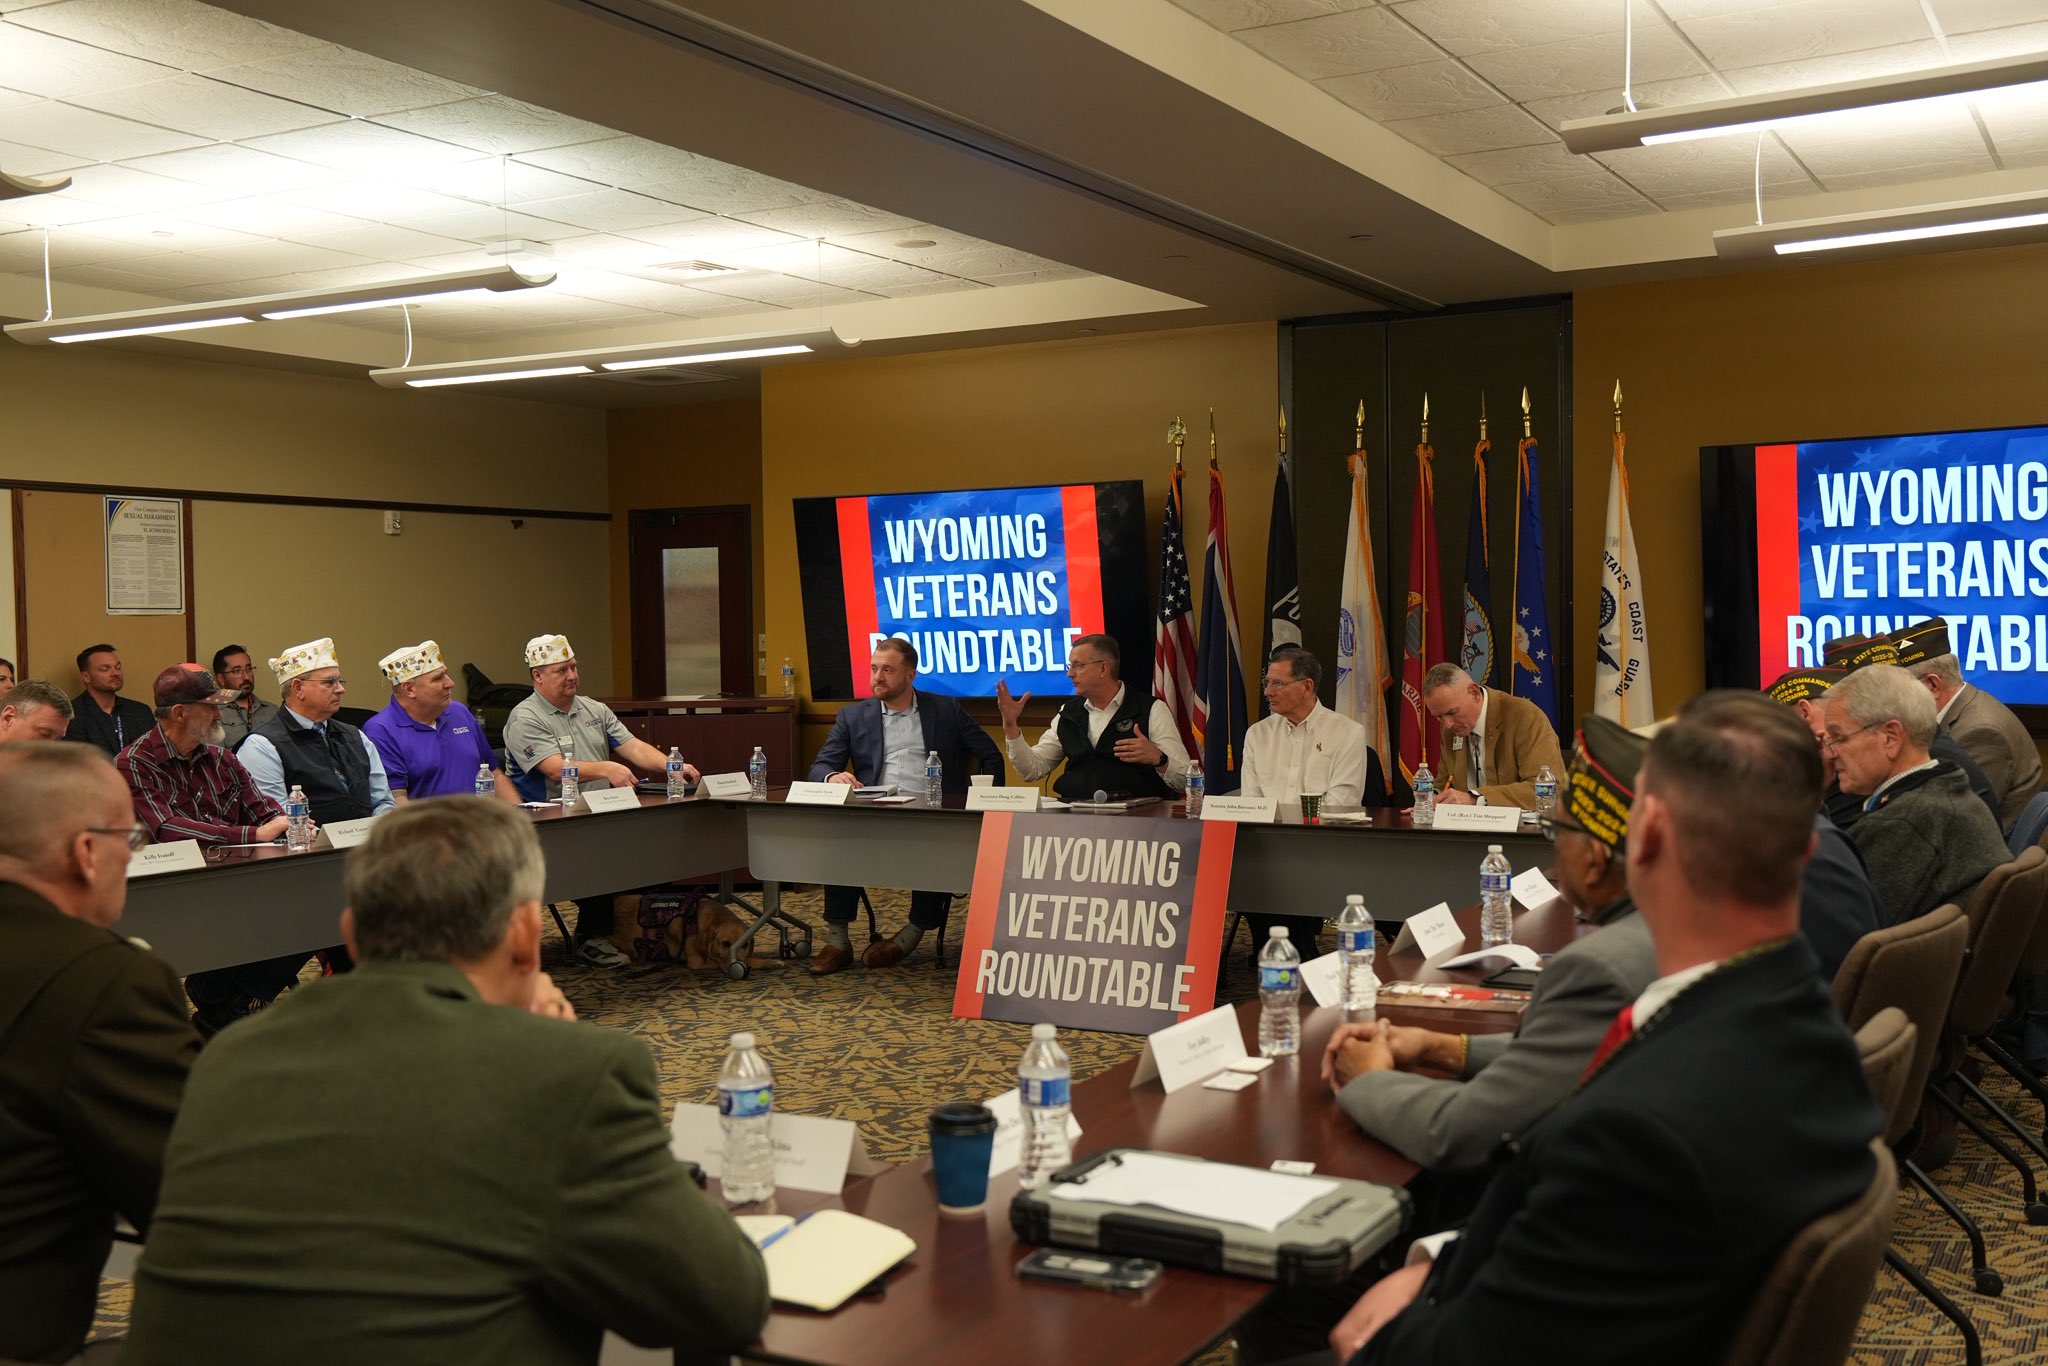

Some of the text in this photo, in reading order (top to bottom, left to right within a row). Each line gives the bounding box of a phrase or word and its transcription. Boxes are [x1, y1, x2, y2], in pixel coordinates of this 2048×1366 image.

[123, 512, 176, 521] SEXUAL HARASSMENT
[1817, 461, 2048, 528] WYOMING
[884, 513, 1047, 564] WYOMING
[1603, 550, 1632, 590] STATES
[1811, 537, 2048, 599] VETERANS
[883, 571, 1059, 620] VETERANS
[1628, 601, 1644, 643] COAST
[1786, 614, 2048, 672] ROTABL
[869, 627, 1082, 675] UNDTABLE
[1853, 649, 1872, 665] STATE
[1900, 651, 1925, 664] YOMING
[1614, 658, 1640, 698] GUARD
[1571, 771, 1597, 793] STATE
[1570, 800, 1618, 845] WYOMING
[1021, 835, 1181, 888] WYOMING
[1008, 892, 1180, 949] VETERANS
[975, 949, 1196, 1013] ROUNDTABLE
